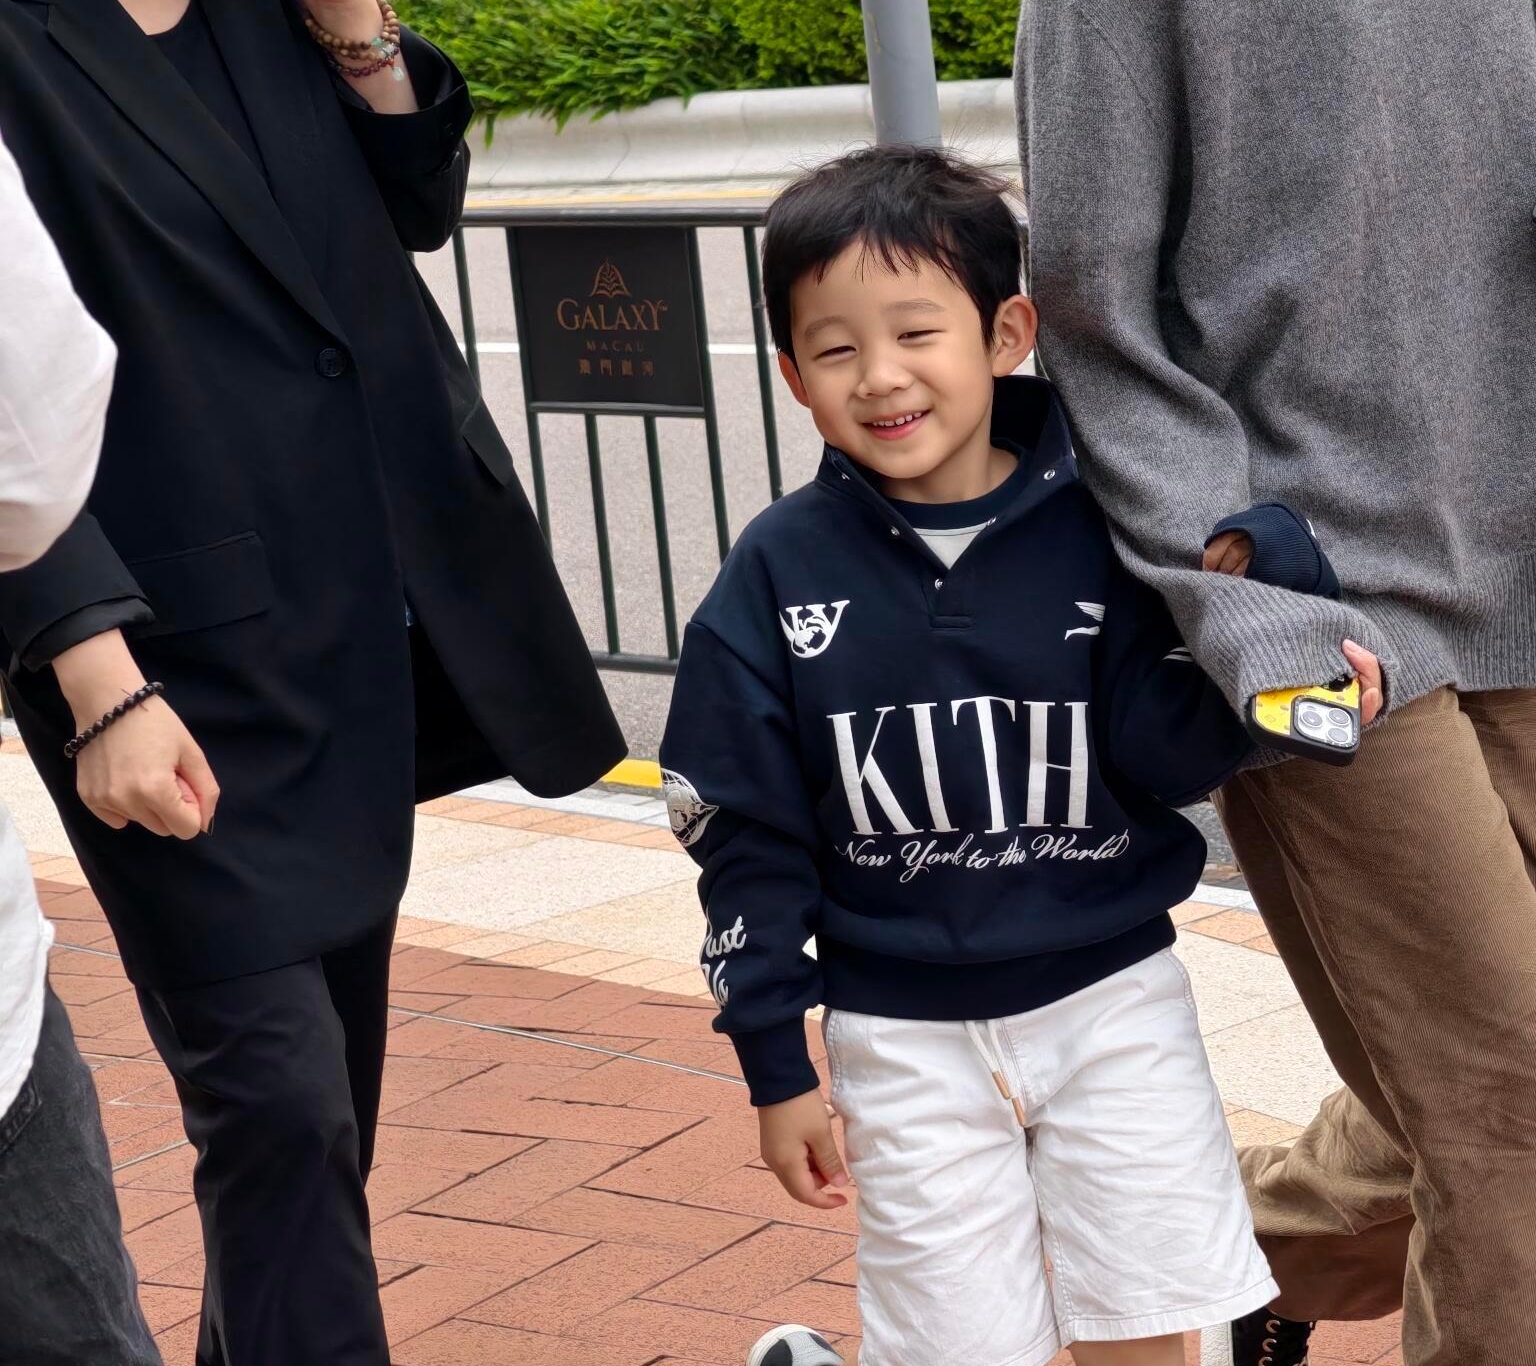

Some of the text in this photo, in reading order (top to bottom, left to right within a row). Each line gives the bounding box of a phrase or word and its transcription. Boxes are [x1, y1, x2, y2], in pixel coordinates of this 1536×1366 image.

[585, 340, 645, 353] MACAU
[826, 696, 1094, 836] KITH
[834, 829, 1130, 884] New York to the World
